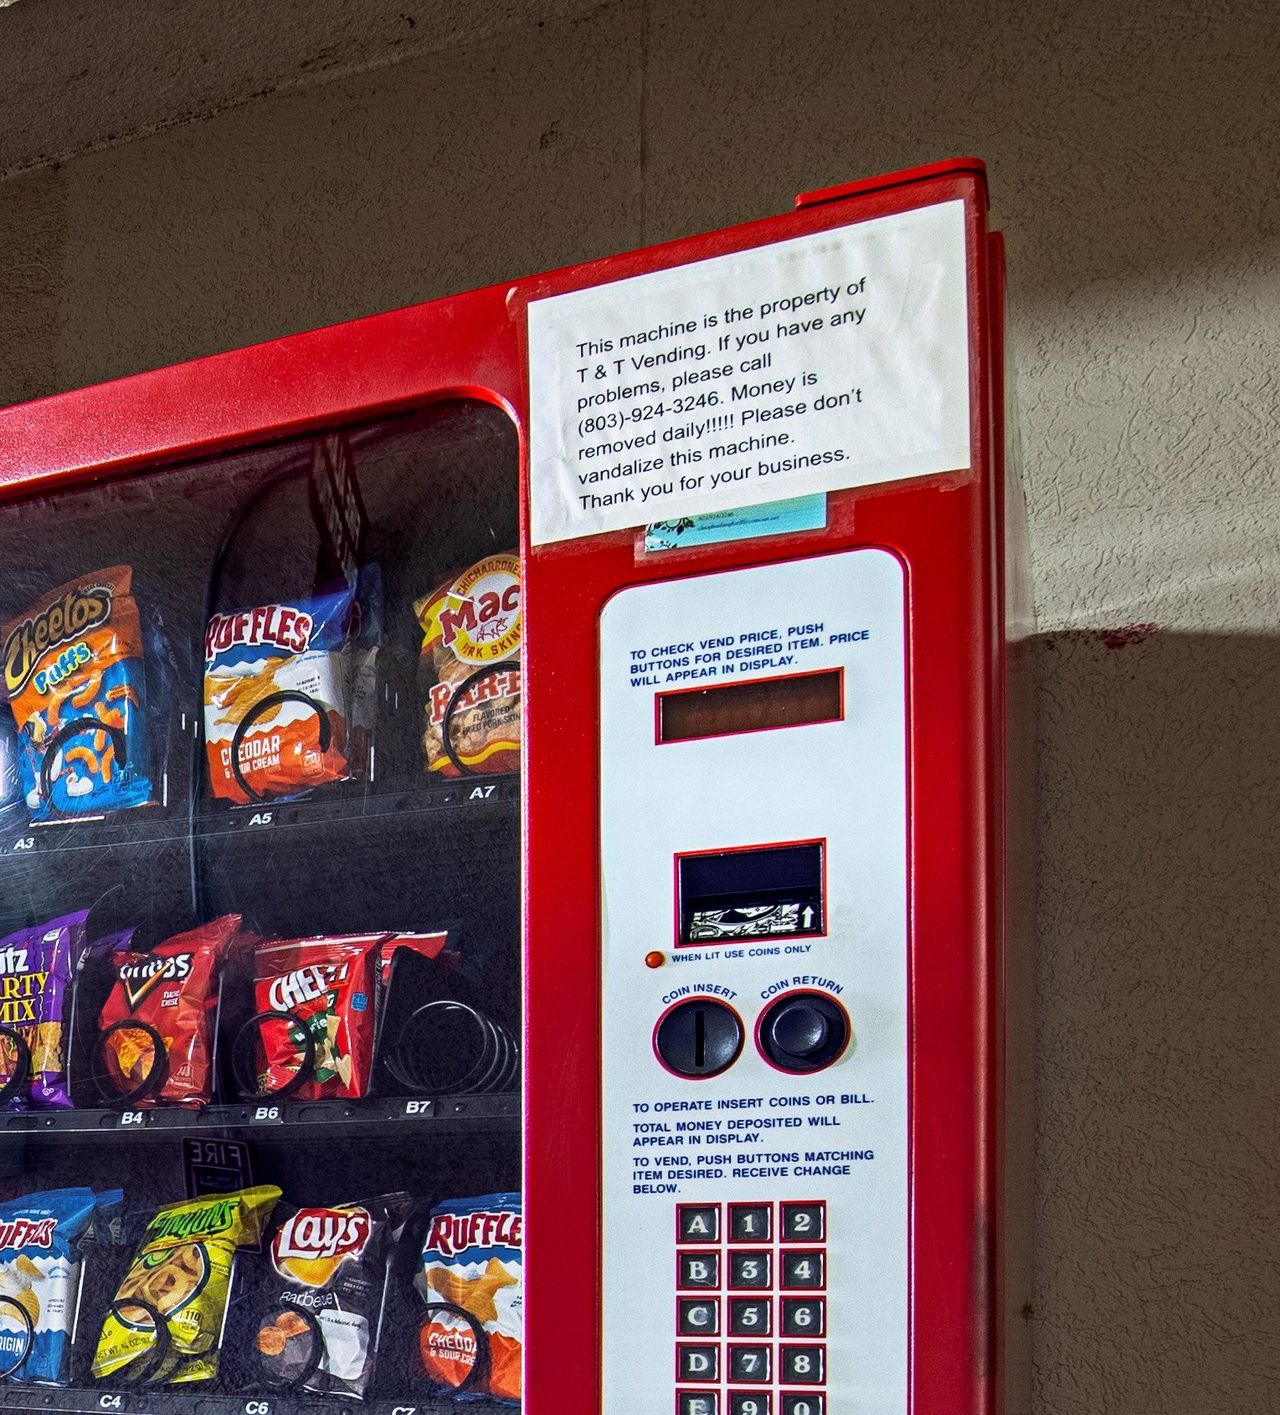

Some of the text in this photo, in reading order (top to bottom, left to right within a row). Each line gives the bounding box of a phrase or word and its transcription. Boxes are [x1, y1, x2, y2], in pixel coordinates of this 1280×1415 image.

[576, 277, 866, 358] This machine is the property of
[577, 308, 866, 383] T & T Vending. If you have any
[578, 352, 771, 413] problems, please call
[578, 372, 817, 438] (803)-924-3246. Money is
[579, 388, 862, 460] removed daily!!!!! Please don't
[578, 433, 794, 485] vandalize this machine.
[579, 450, 849, 510] Thank you for your business.
[4, 588, 105, 691] Cheetos
[205, 605, 311, 661] RUFFLES
[630, 623, 823, 660] TO CHECK VEND PRICE, PUSH
[630, 630, 869, 674] BUTTONS FOR DESIRED ITEM. PRICE
[33, 642, 91, 694] Puffs
[630, 655, 797, 687] WILL APPEAR IN DISPLAY.
[252, 753, 281, 772] CREAM
[469, 786, 495, 800] A7
[248, 812, 273, 826] A5
[13, 838, 35, 850] A3
[670, 944, 812, 964] WHEN LIT USE COINS ONLY
[662, 983, 738, 1005] COIN INSERT
[760, 975, 844, 1000] COIN RETURN
[405, 1100, 431, 1114] B7
[633, 1094, 874, 1113] TO OPERATE INSERT COINS OR BILL.
[120, 1112, 143, 1125] B4
[254, 1107, 279, 1120] B6
[633, 1116, 840, 1133] TOTAL MONEY DEPOSITED WILL
[633, 1133, 763, 1147] APPEAR IN DISPLAY.
[633, 1150, 874, 1167] TO VEND, PUSH BUTTONS MATCHING
[633, 1165, 850, 1180] ITEM DESIRED. RECEIVE CHANGE
[633, 1184, 681, 1194] BELOW.
[278, 1211, 369, 1259] Lay's
[184, 1310, 200, 1321] 110
[438, 1349, 460, 1360] SOUR
[99, 1395, 122, 1408] C4
[245, 1402, 269, 1415] C6
